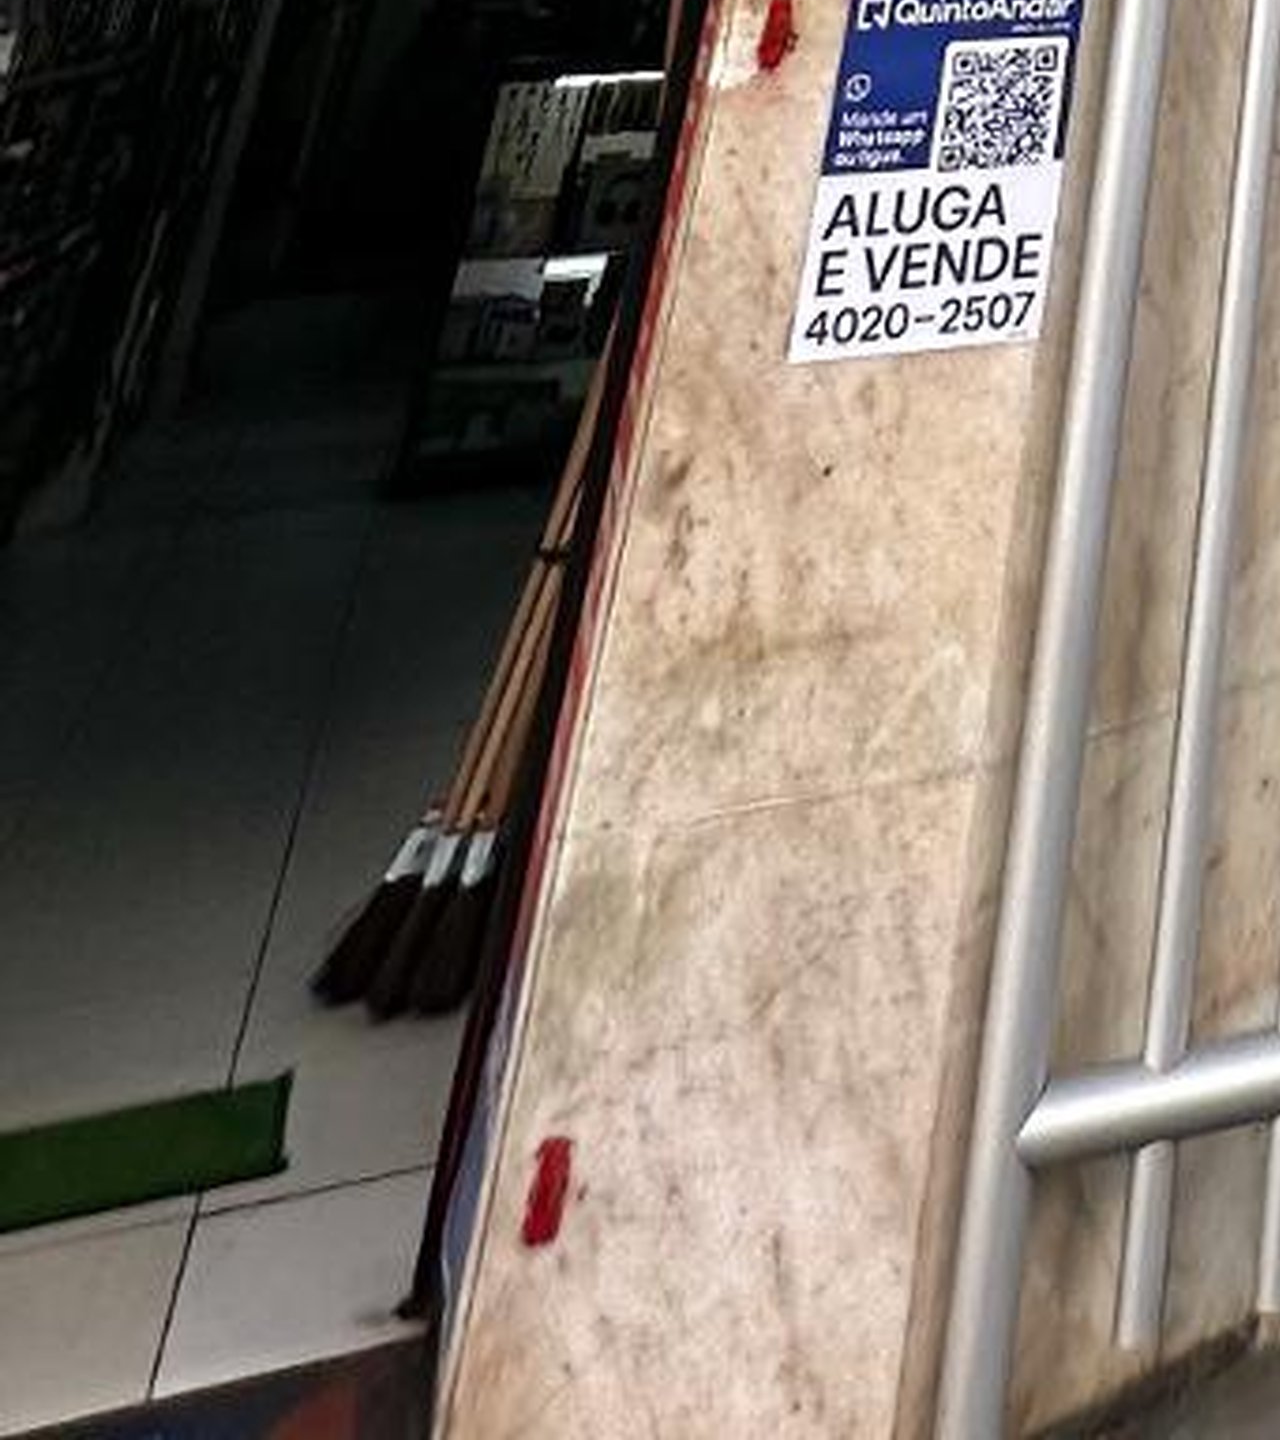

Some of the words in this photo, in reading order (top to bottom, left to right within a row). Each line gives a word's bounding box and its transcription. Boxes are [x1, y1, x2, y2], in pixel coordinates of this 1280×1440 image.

[822, 182, 1008, 243] ALUGA
[814, 247, 851, 299] E
[863, 232, 1044, 294] VENDE
[803, 290, 1037, 347] 4020-2507
